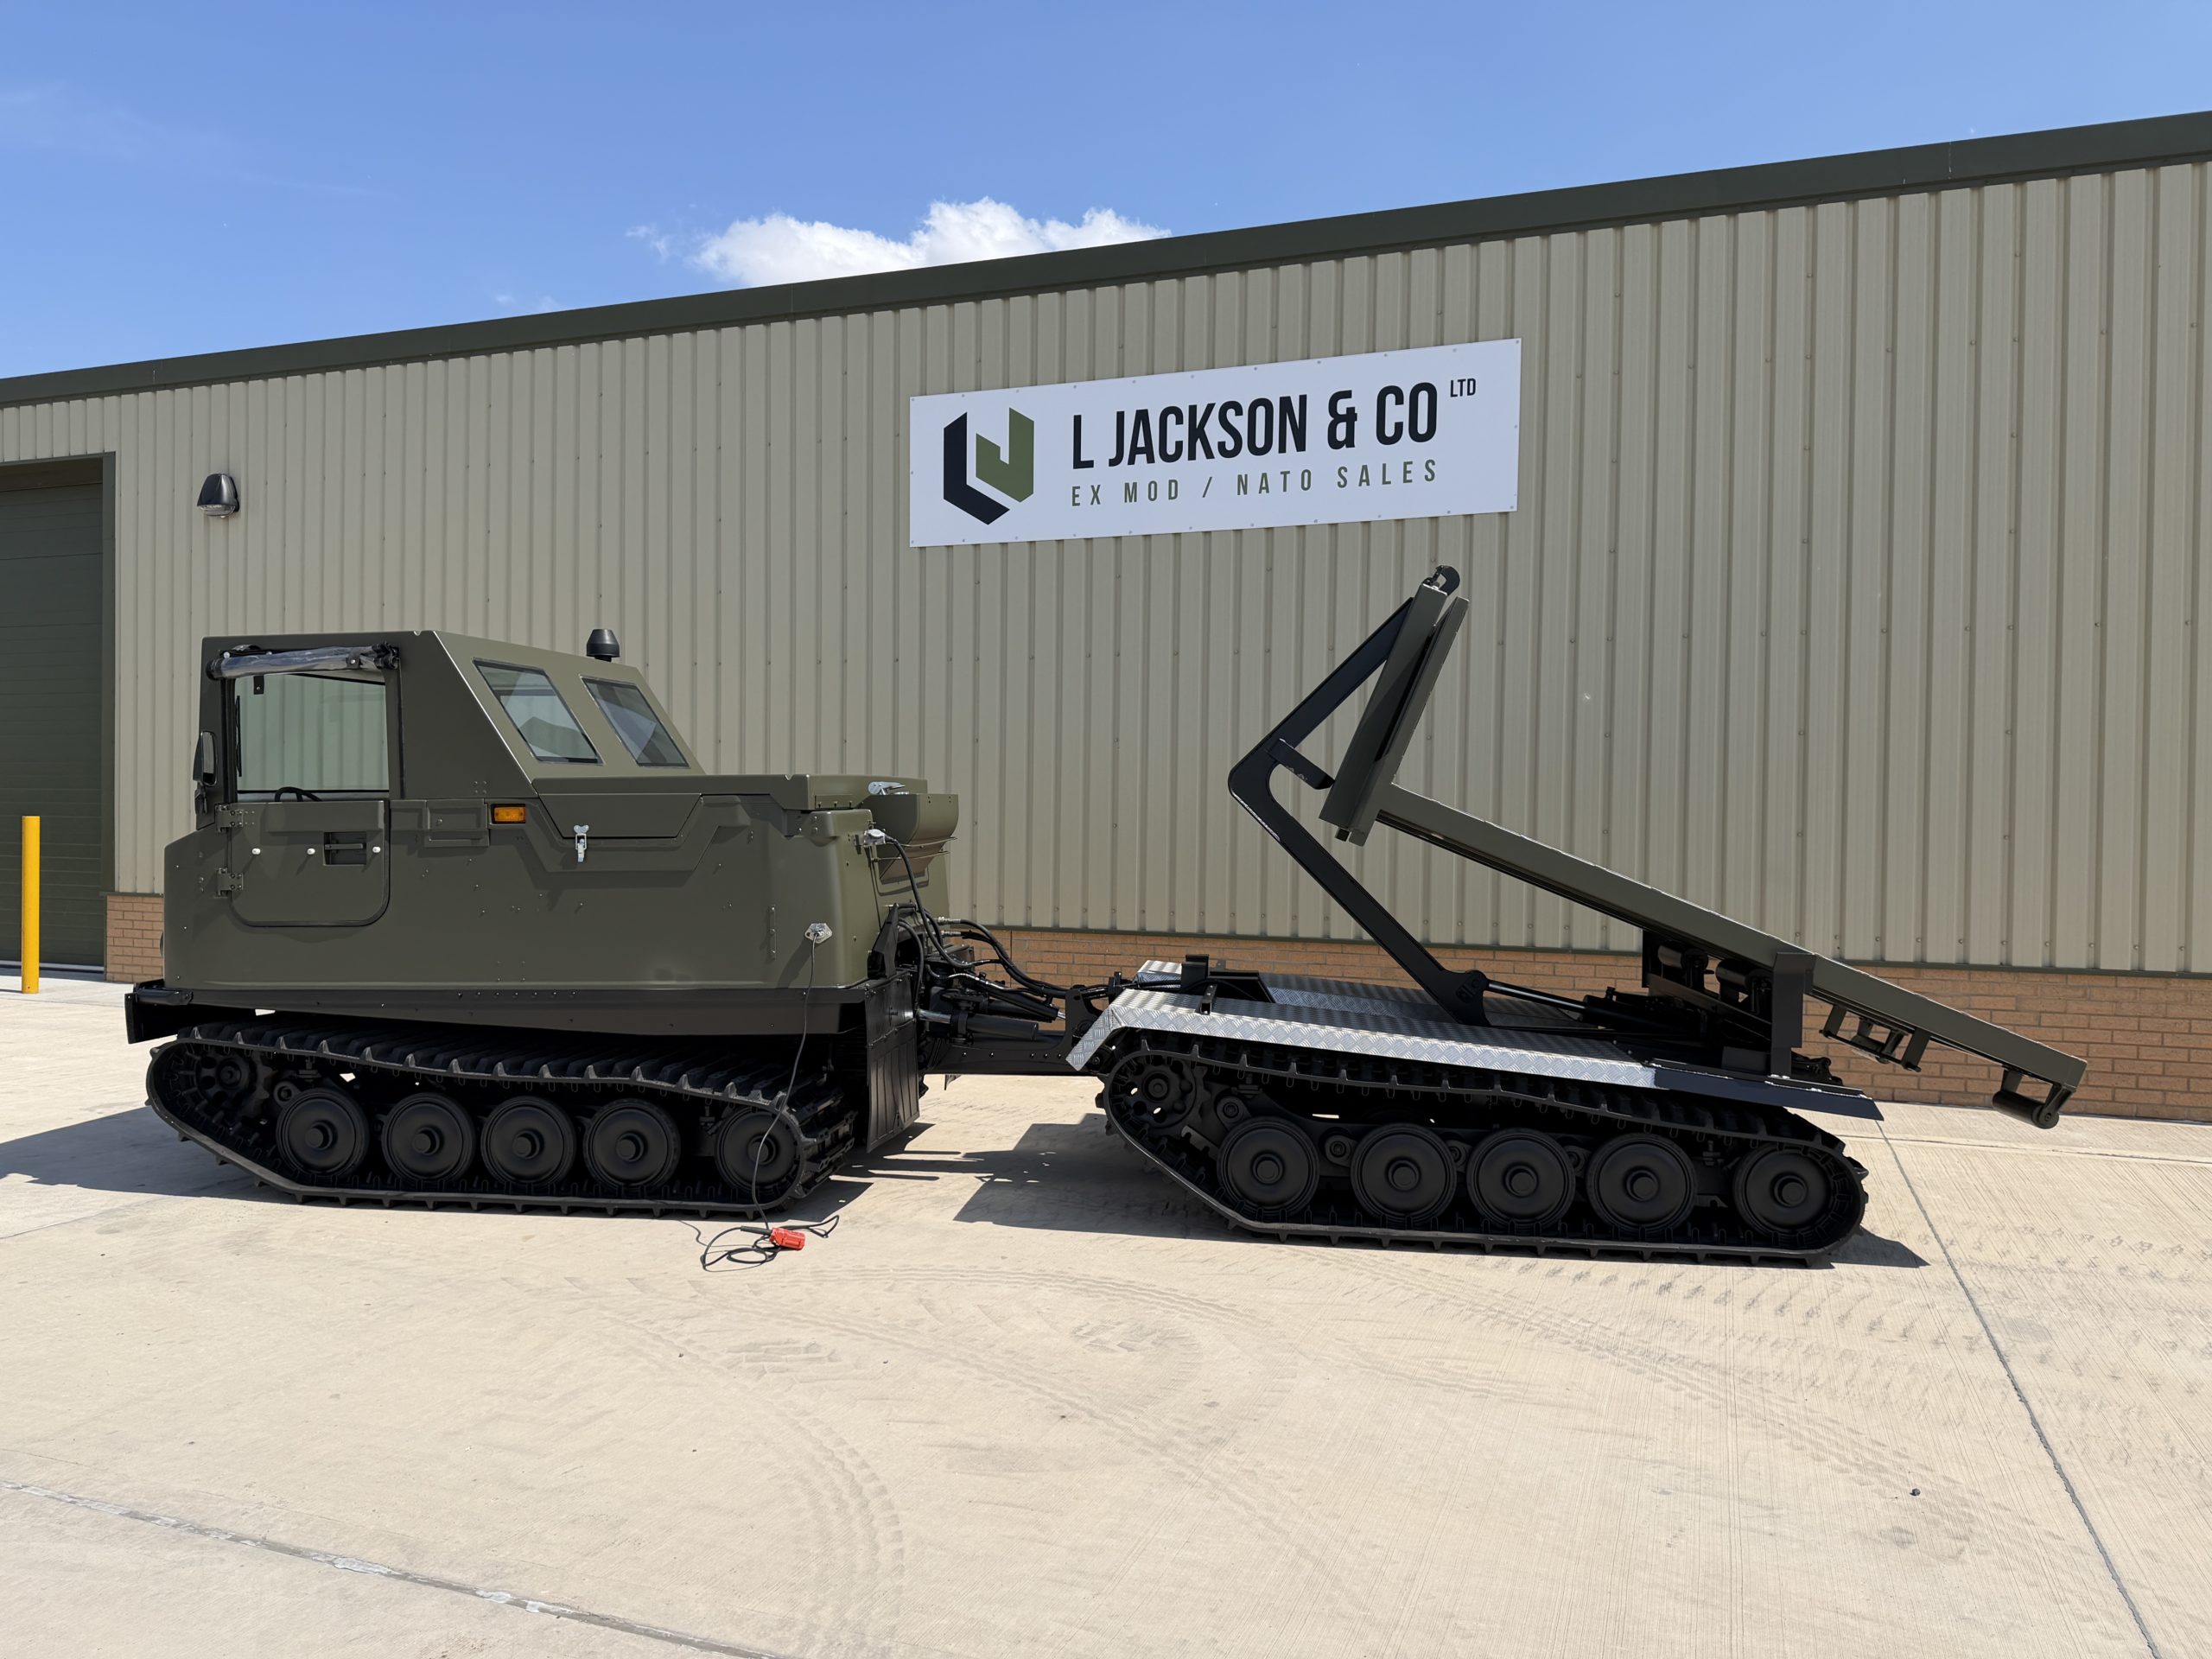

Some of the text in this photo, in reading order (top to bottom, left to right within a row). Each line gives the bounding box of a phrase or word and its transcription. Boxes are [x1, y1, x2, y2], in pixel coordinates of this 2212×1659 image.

[1072, 378, 1477, 470] L JACKSON & CO LTD
[1071, 459, 1436, 507] EX MOD / NATO SALES
